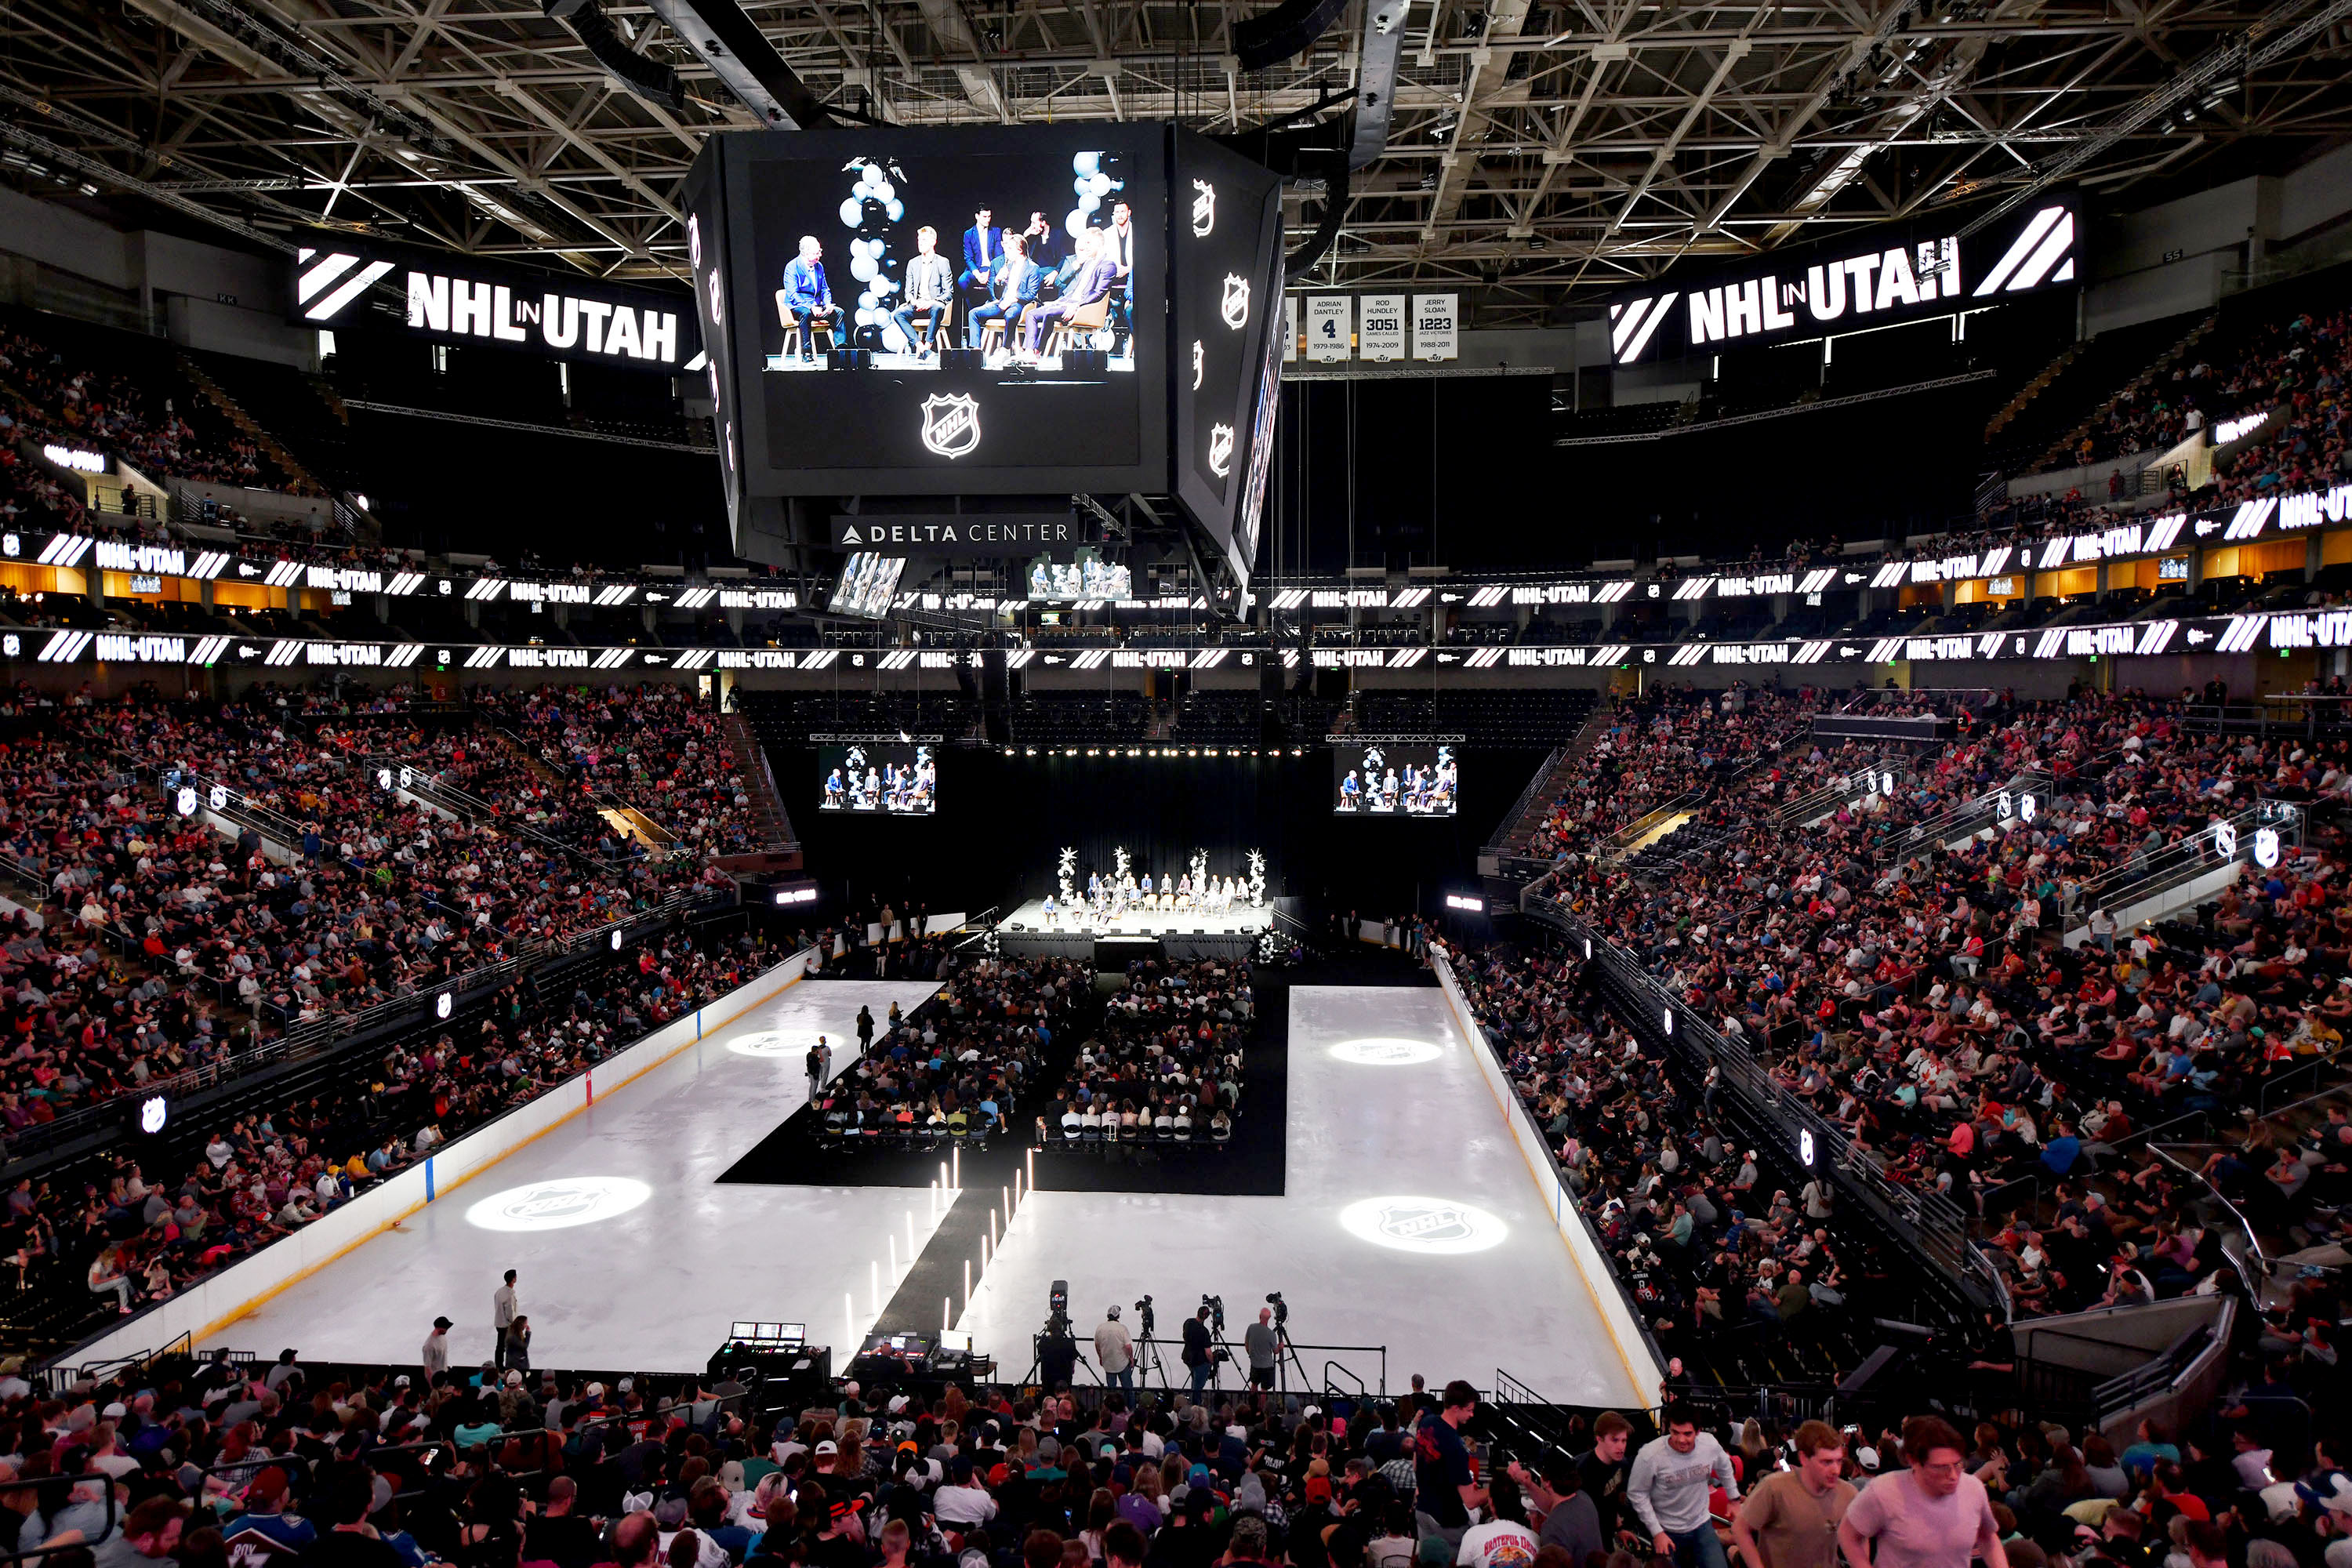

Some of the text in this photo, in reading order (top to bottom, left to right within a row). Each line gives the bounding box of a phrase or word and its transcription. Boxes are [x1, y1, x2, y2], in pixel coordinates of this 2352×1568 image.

[1689, 235, 1961, 344] NHL IN UTAH
[408, 271, 677, 362] NHL IN UTAH
[1366, 318, 1399, 331] 3051
[1419, 318, 1452, 330] 1223
[1322, 319, 1336, 339] 4
[935, 409, 968, 445] NHL
[2279, 491, 2323, 529] NHL
[870, 524, 1069, 543] DELTA CENTER
[2073, 533, 2101, 561] NHL
[2103, 524, 2141, 557] UTAH
[96, 541, 136, 570] NHL
[139, 546, 185, 575] UTAH
[1911, 560, 1940, 583] NHL
[1943, 554, 1977, 579] UTAH
[307, 566, 338, 589] NHL
[339, 568, 382, 592] UTAH
[1718, 577, 1750, 597] NHL
[1754, 573, 1793, 594] UTAH
[510, 583, 545, 601] NHL
[548, 584, 590, 603] UTAH
[720, 590, 753, 608] NHL
[756, 592, 797, 608] UTAH
[1312, 591, 1344, 607] NHL
[1348, 590, 1387, 607] UTAH
[1512, 587, 1544, 604] NHL
[1548, 585, 1589, 603] UTAH
[2067, 630, 2094, 655] NHL
[2096, 626, 2134, 653] UTAH
[2270, 614, 2313, 648] NHL
[96, 634, 136, 661] NHL
[139, 637, 185, 662] UTAH
[307, 644, 338, 665] NHL
[340, 644, 381, 665] UTAH
[510, 649, 543, 666] NHL
[546, 650, 588, 667] UTAH
[1344, 650, 1384, 666] UTAH
[1508, 649, 1541, 666] NHL
[1544, 648, 1585, 665] UTAH
[1713, 645, 1746, 663] NHL
[1749, 644, 1788, 663] UTAH
[1906, 639, 1934, 659] NHL
[1937, 637, 1972, 659] UTAH
[718, 652, 750, 667] NHL
[753, 652, 795, 667] UTAH
[920, 652, 951, 667] NHL
[1112, 652, 1144, 667] NHL
[1147, 652, 1186, 667] UTAH
[1399, 1214, 1454, 1236] NHL
[233, 1543, 257, 1556] ROY
